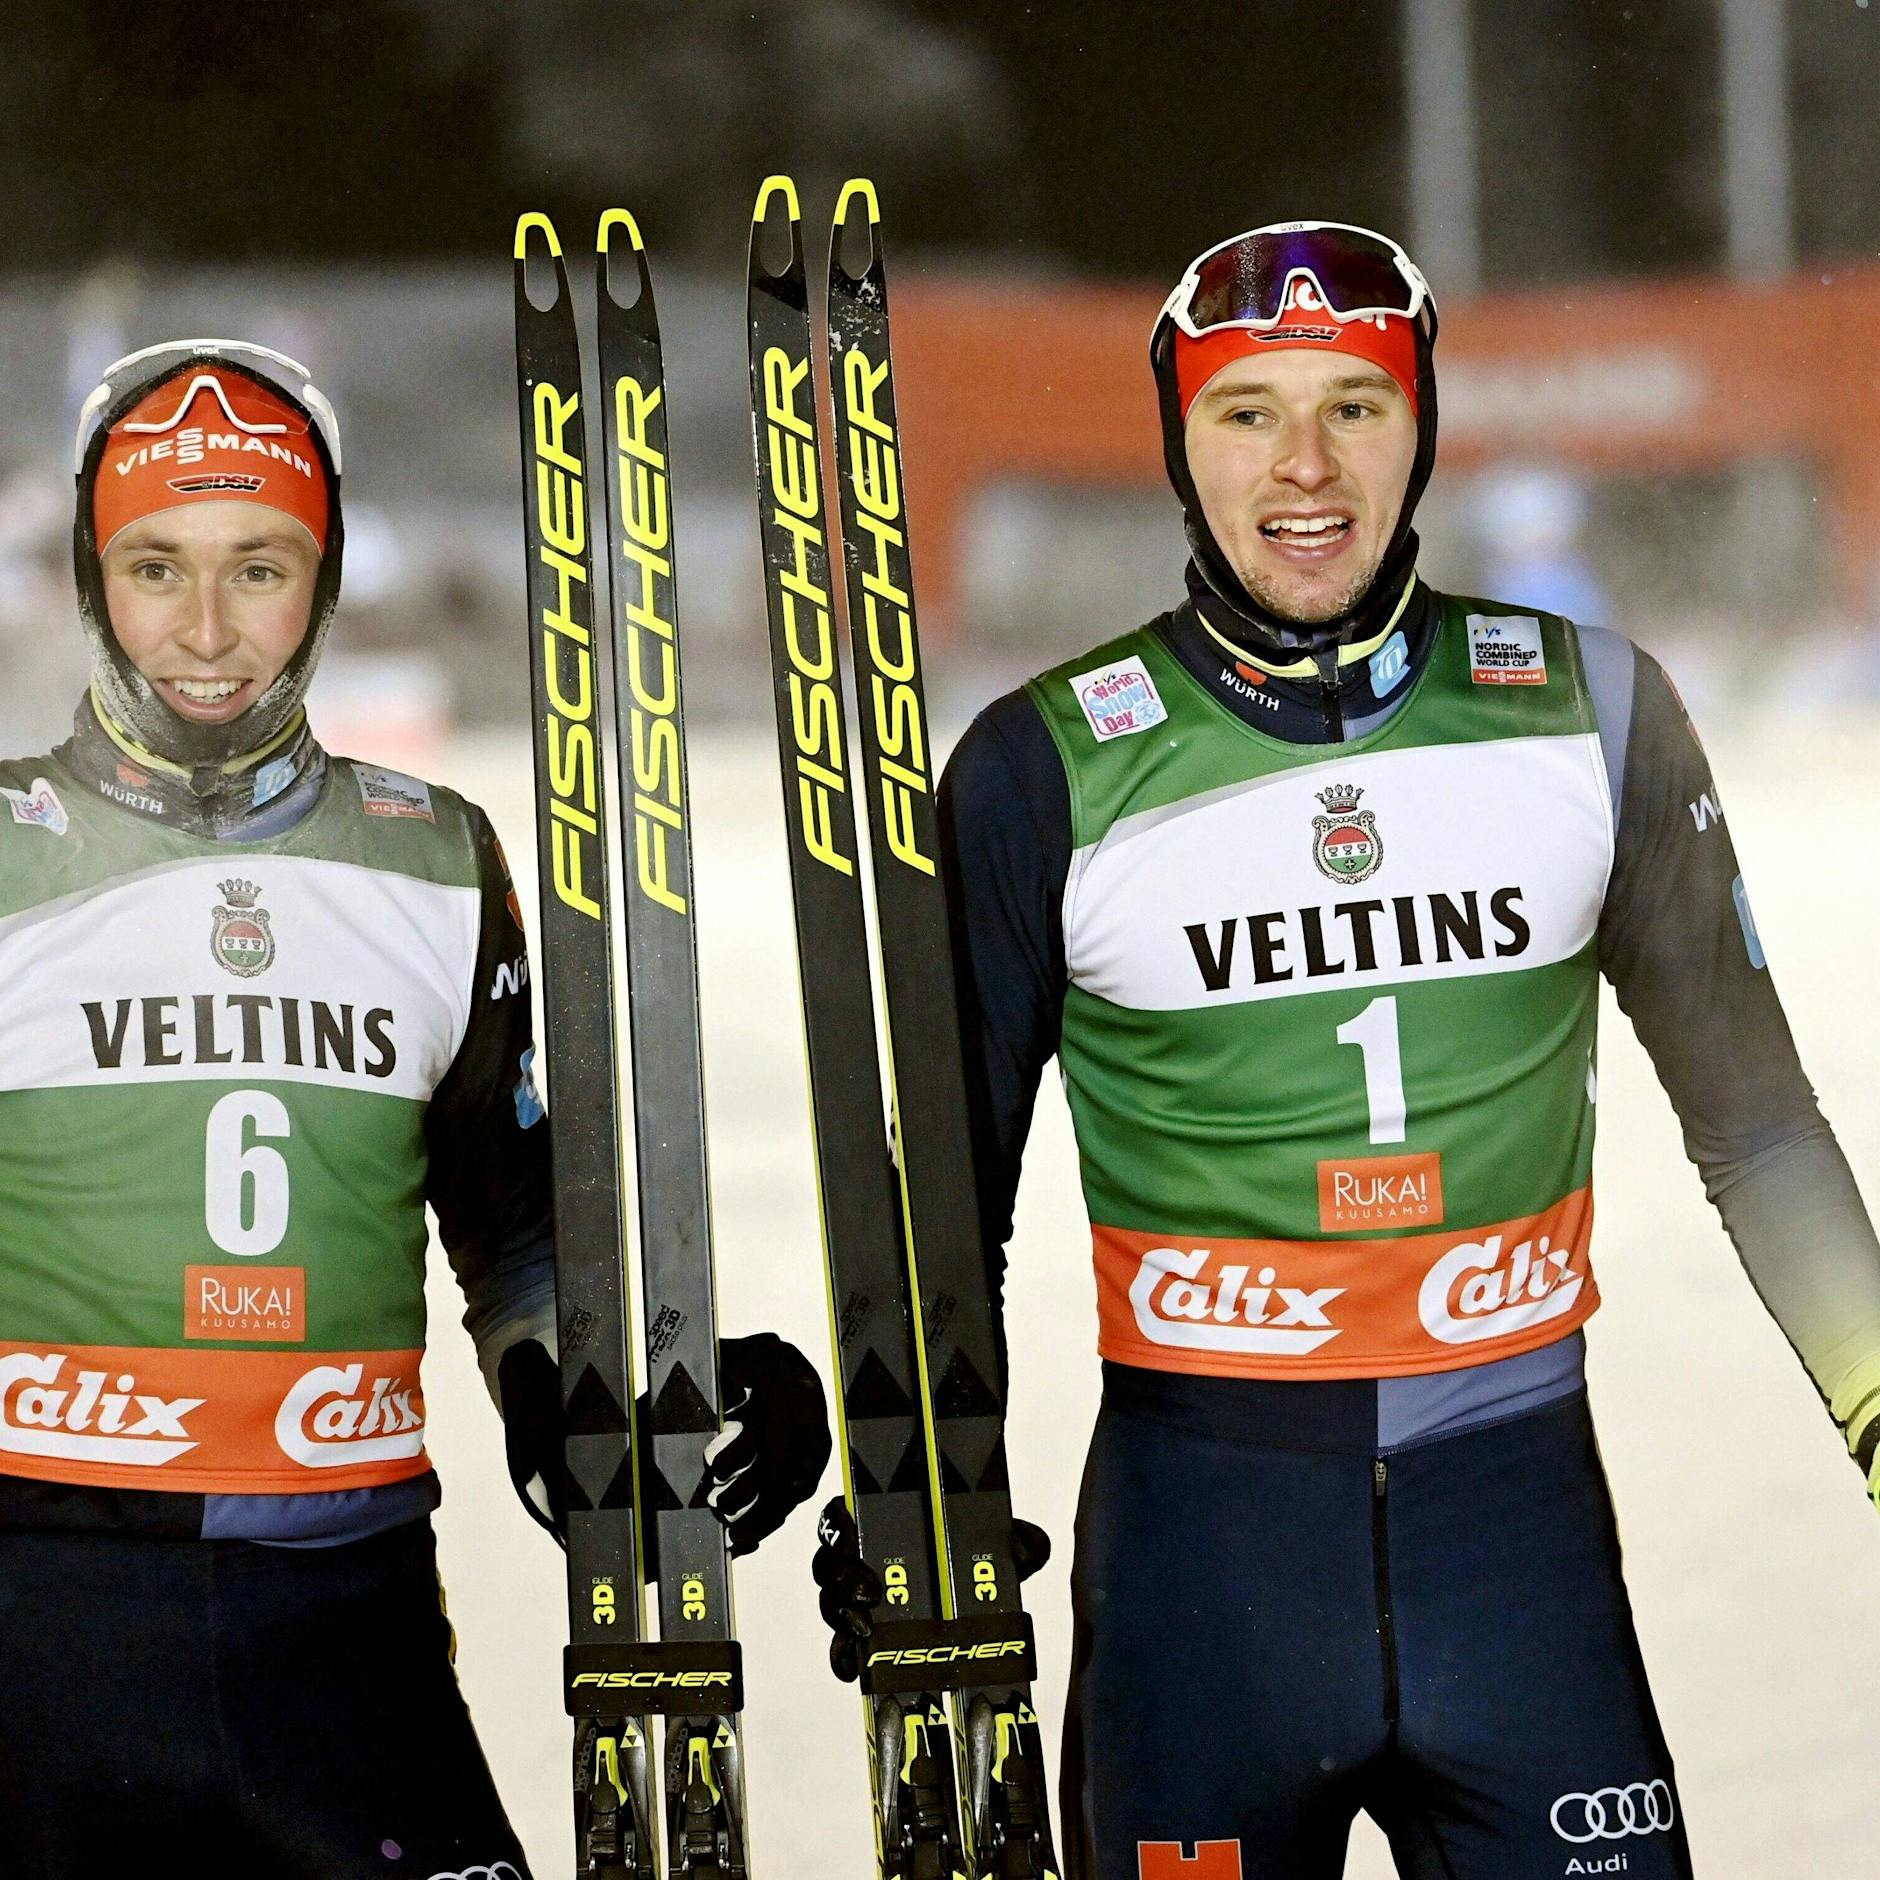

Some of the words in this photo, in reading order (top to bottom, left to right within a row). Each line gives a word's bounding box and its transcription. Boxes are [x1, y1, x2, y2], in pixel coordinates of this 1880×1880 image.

[1280, 223, 1304, 232] uvex
[193, 345, 220, 355] uvex
[115, 427, 312, 479] VIESSMANN
[764, 347, 853, 875] FISCHER
[844, 350, 936, 876] FISCHER
[534, 382, 601, 919] FISCHER
[616, 375, 685, 913] FISCHER
[1475, 642, 1521, 652] NORDIC
[1475, 650, 1537, 660] COMBINED
[1476, 659, 1510, 667] WORLD
[1478, 671, 1540, 683] VIESSMANN
[1103, 711, 1134, 732] Day
[1183, 887, 1531, 993] VELTINS
[80, 994, 397, 1078] VELTINS
[1336, 996, 1407, 1144] 1
[205, 1089, 291, 1256] 6
[1335, 1171, 1427, 1207] RUKA!
[1336, 1204, 1428, 1220] KUUSAMO
[200, 1276, 292, 1317] RUKA!
[1129, 1248, 1349, 1356] Calix
[200, 1317, 291, 1330] KUUSAMO
[648, 1303, 671, 1338] speed
[664, 1309, 681, 1331] 3D
[0, 1352, 208, 1466] Calix
[274, 1363, 425, 1468] Calix
[972, 1553, 994, 1562] GLIDE
[591, 1576, 614, 1585] GLIDE
[681, 1572, 704, 1580] GLIDE
[884, 1564, 909, 1605] 3D
[973, 1561, 998, 1602] 3D
[592, 1584, 616, 1625] 3D
[682, 1580, 706, 1621] 3D
[866, 1640, 1026, 1668] FISCHER
[571, 1671, 733, 1689] FISCHER
[1564, 1853, 1628, 1876] Audi
